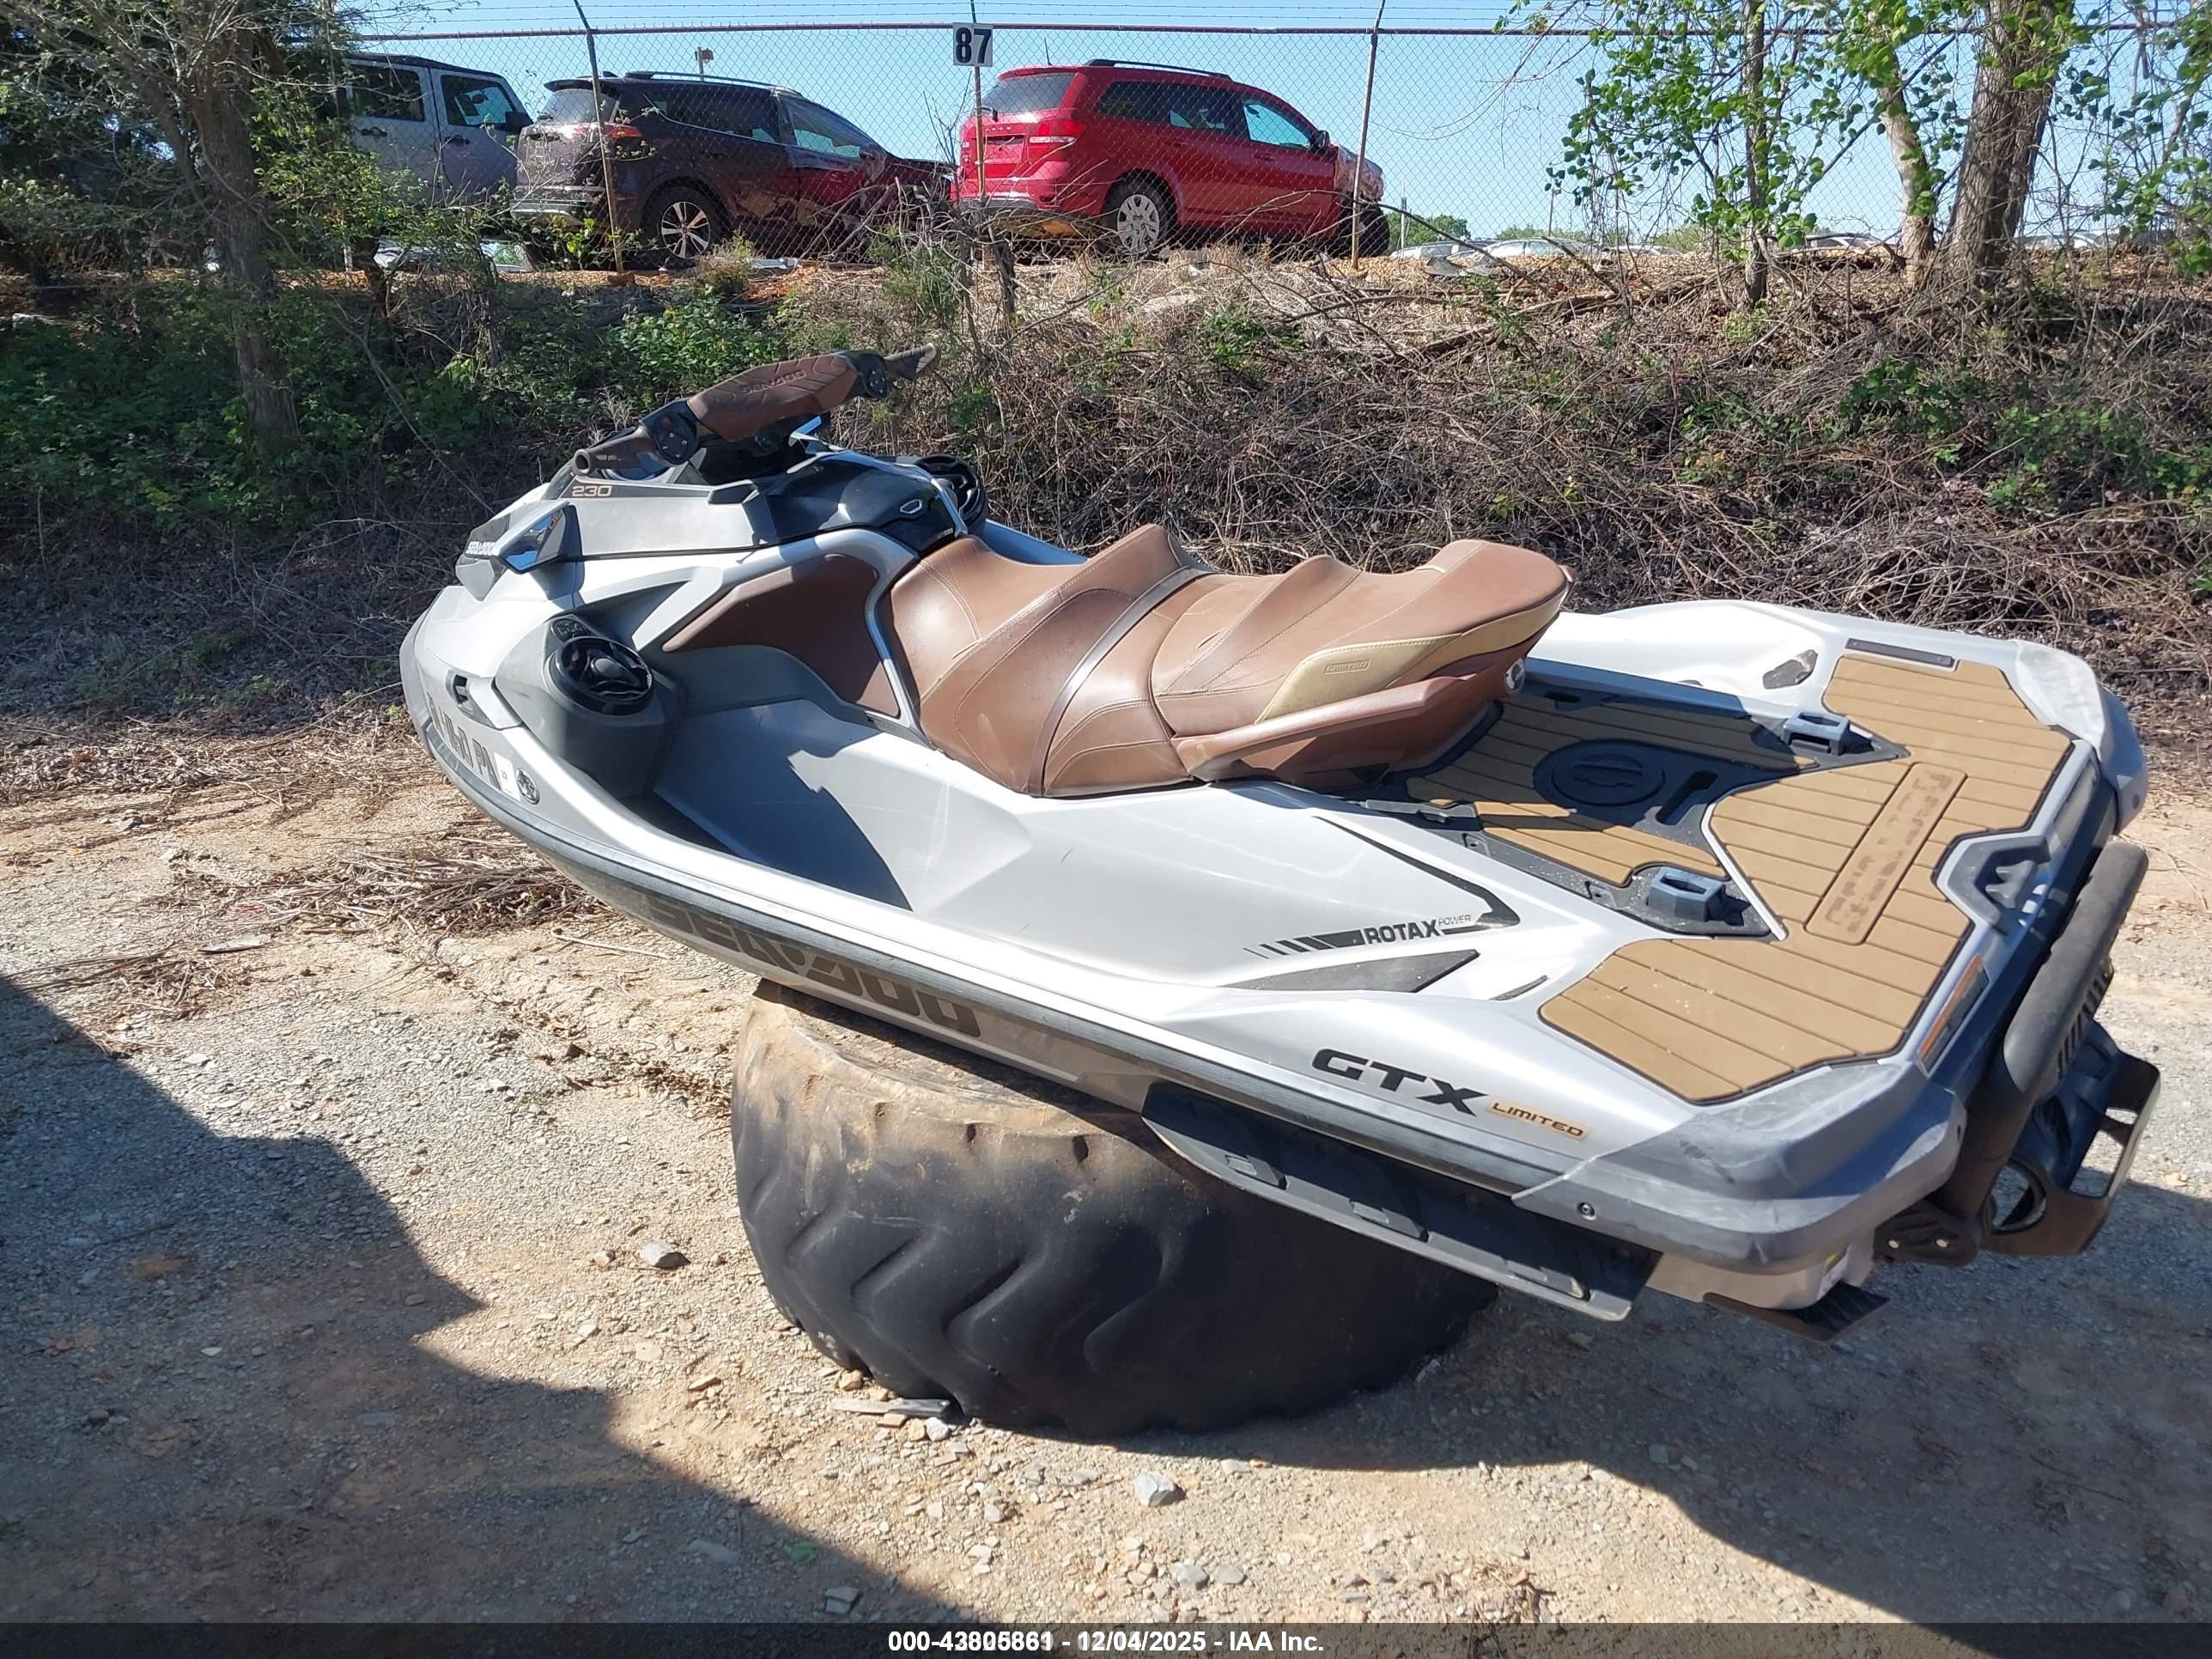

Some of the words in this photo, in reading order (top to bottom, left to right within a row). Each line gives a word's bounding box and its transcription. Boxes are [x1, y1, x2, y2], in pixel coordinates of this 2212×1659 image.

[955, 27, 992, 64] 87
[572, 485, 611, 497] 230
[1364, 920, 1440, 945] ROTAX
[1437, 915, 1471, 927] POWER
[1311, 1048, 1489, 1117] GTX
[1492, 1102, 1584, 1137] LIMITED
